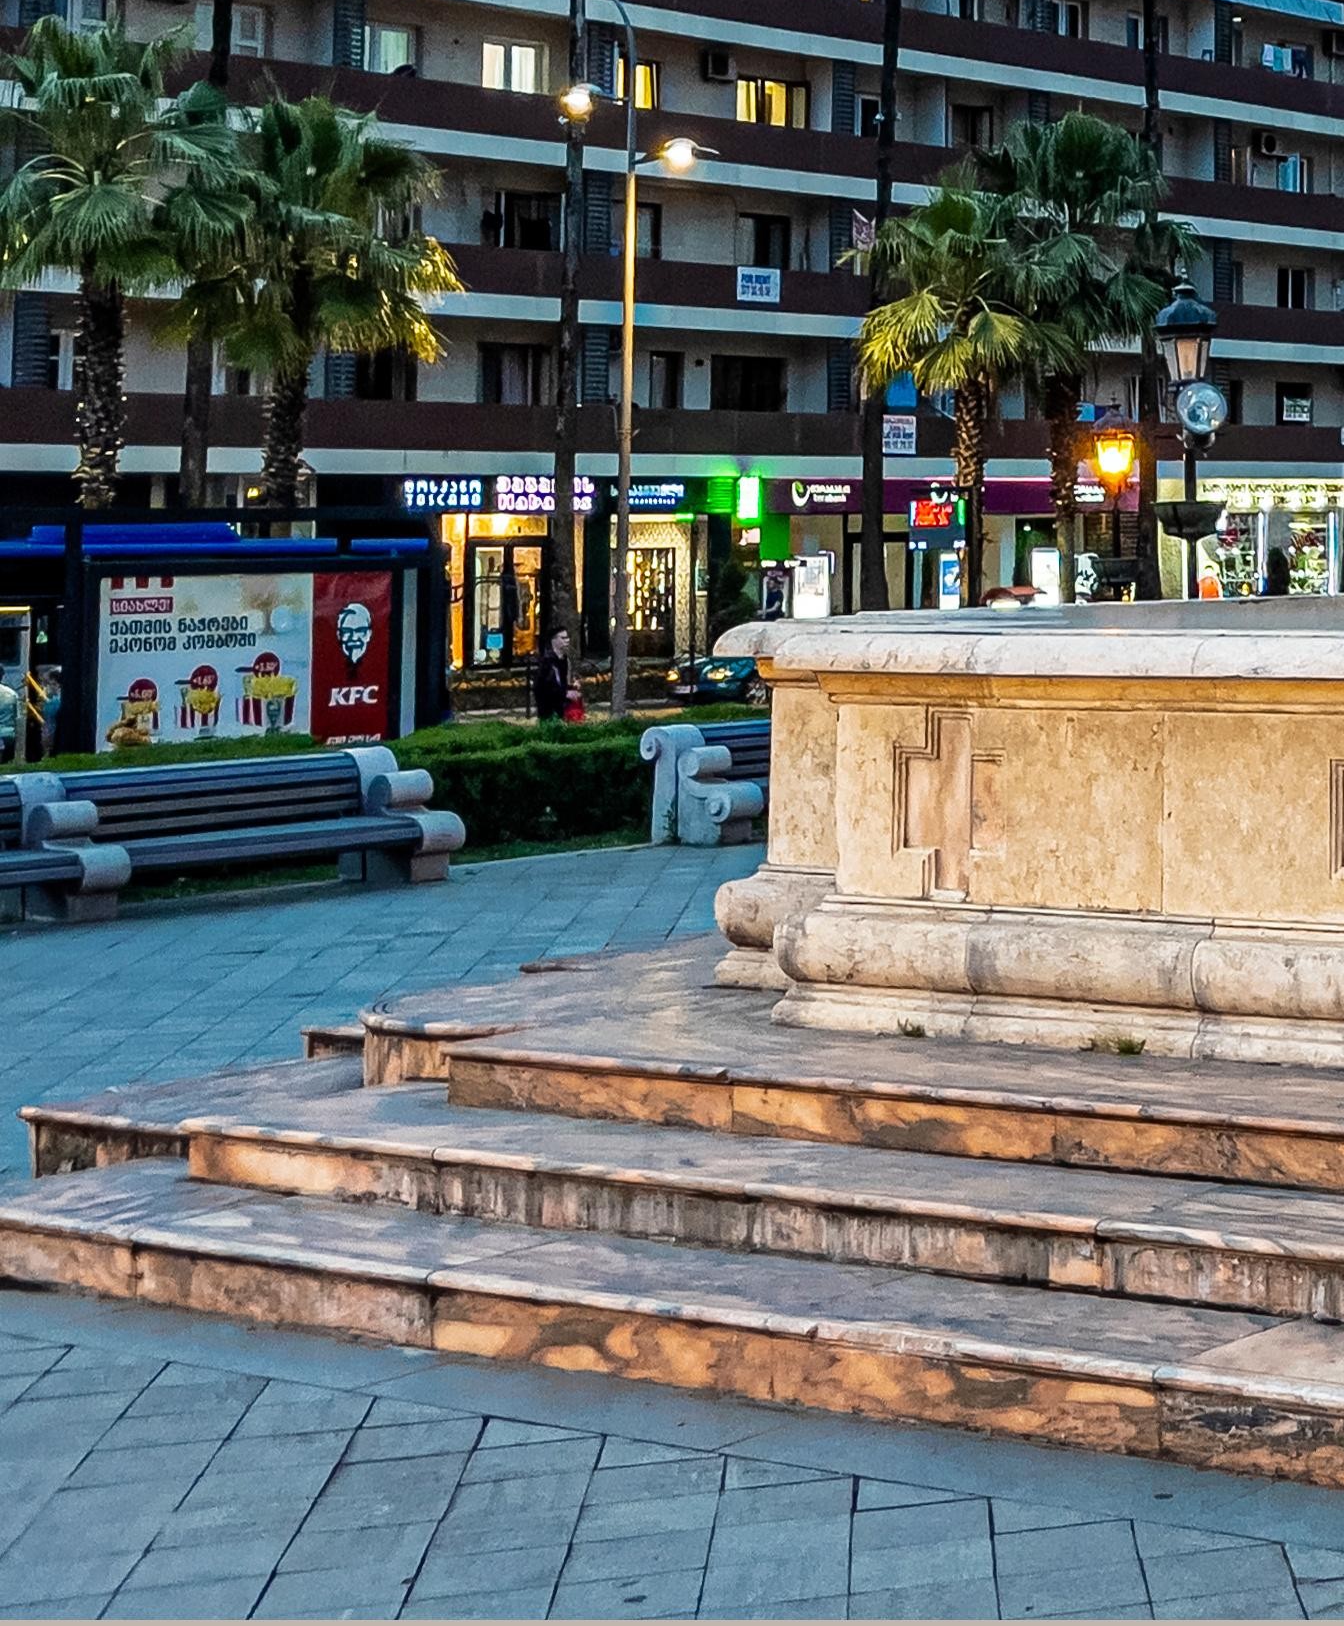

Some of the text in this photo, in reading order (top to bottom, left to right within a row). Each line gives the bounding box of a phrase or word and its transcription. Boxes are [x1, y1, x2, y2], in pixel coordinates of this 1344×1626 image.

[112, 599, 170, 612] სიახლე!
[110, 616, 248, 636] ქათმის ნაჭრები
[109, 633, 256, 654] ეკონომ კომბოში
[328, 685, 379, 707] KFC
